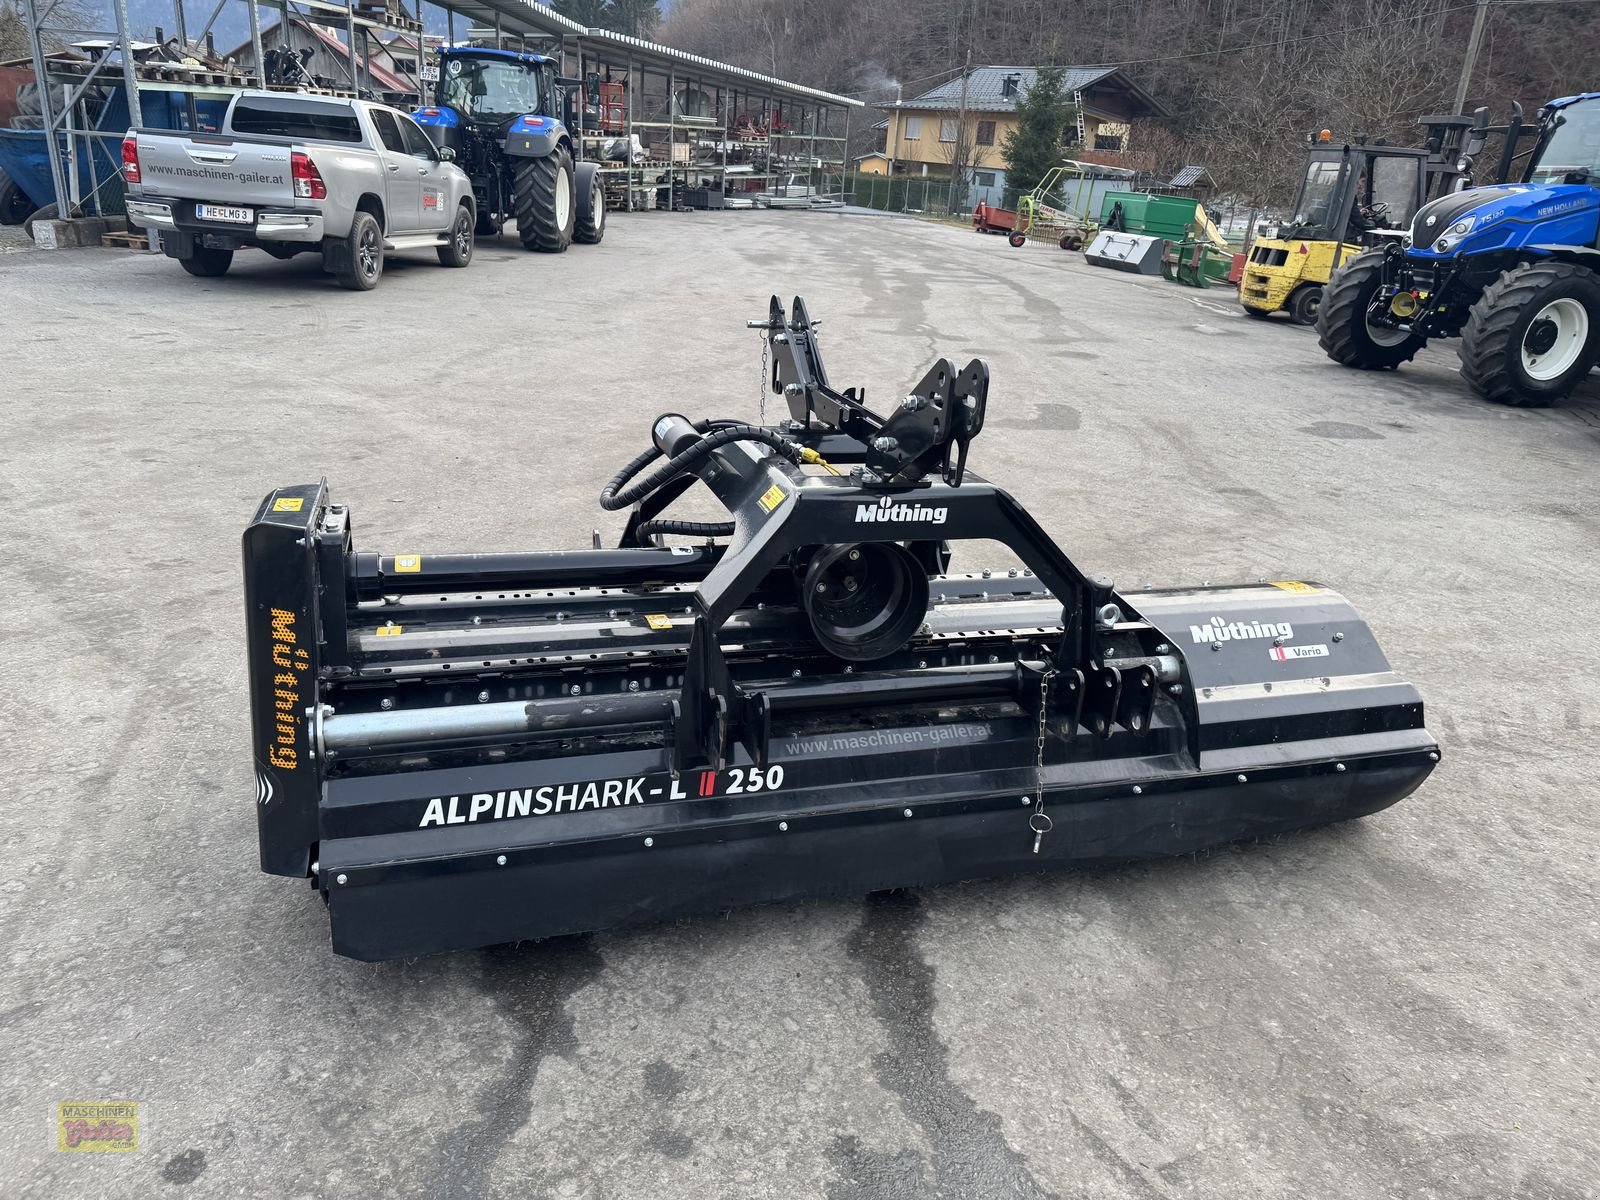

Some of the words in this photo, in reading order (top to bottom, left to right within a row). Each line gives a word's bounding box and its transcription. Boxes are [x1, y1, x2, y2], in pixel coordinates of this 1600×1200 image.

[451, 62, 460, 72] 40
[147, 163, 284, 185] www.maschinen-gailer.at
[206, 207, 218, 217] HE
[223, 208, 240, 219] LMG
[241, 209, 248, 220] 3
[1537, 206, 1554, 217] NEW
[1554, 198, 1587, 212] HOLLAND
[854, 495, 949, 525] Müthing
[1189, 616, 1294, 644] Müthing
[1292, 646, 1322, 658] Vario
[269, 607, 310, 770] Müthing
[786, 723, 994, 755] www.maschinen-gailer.at
[725, 764, 785, 796] 250
